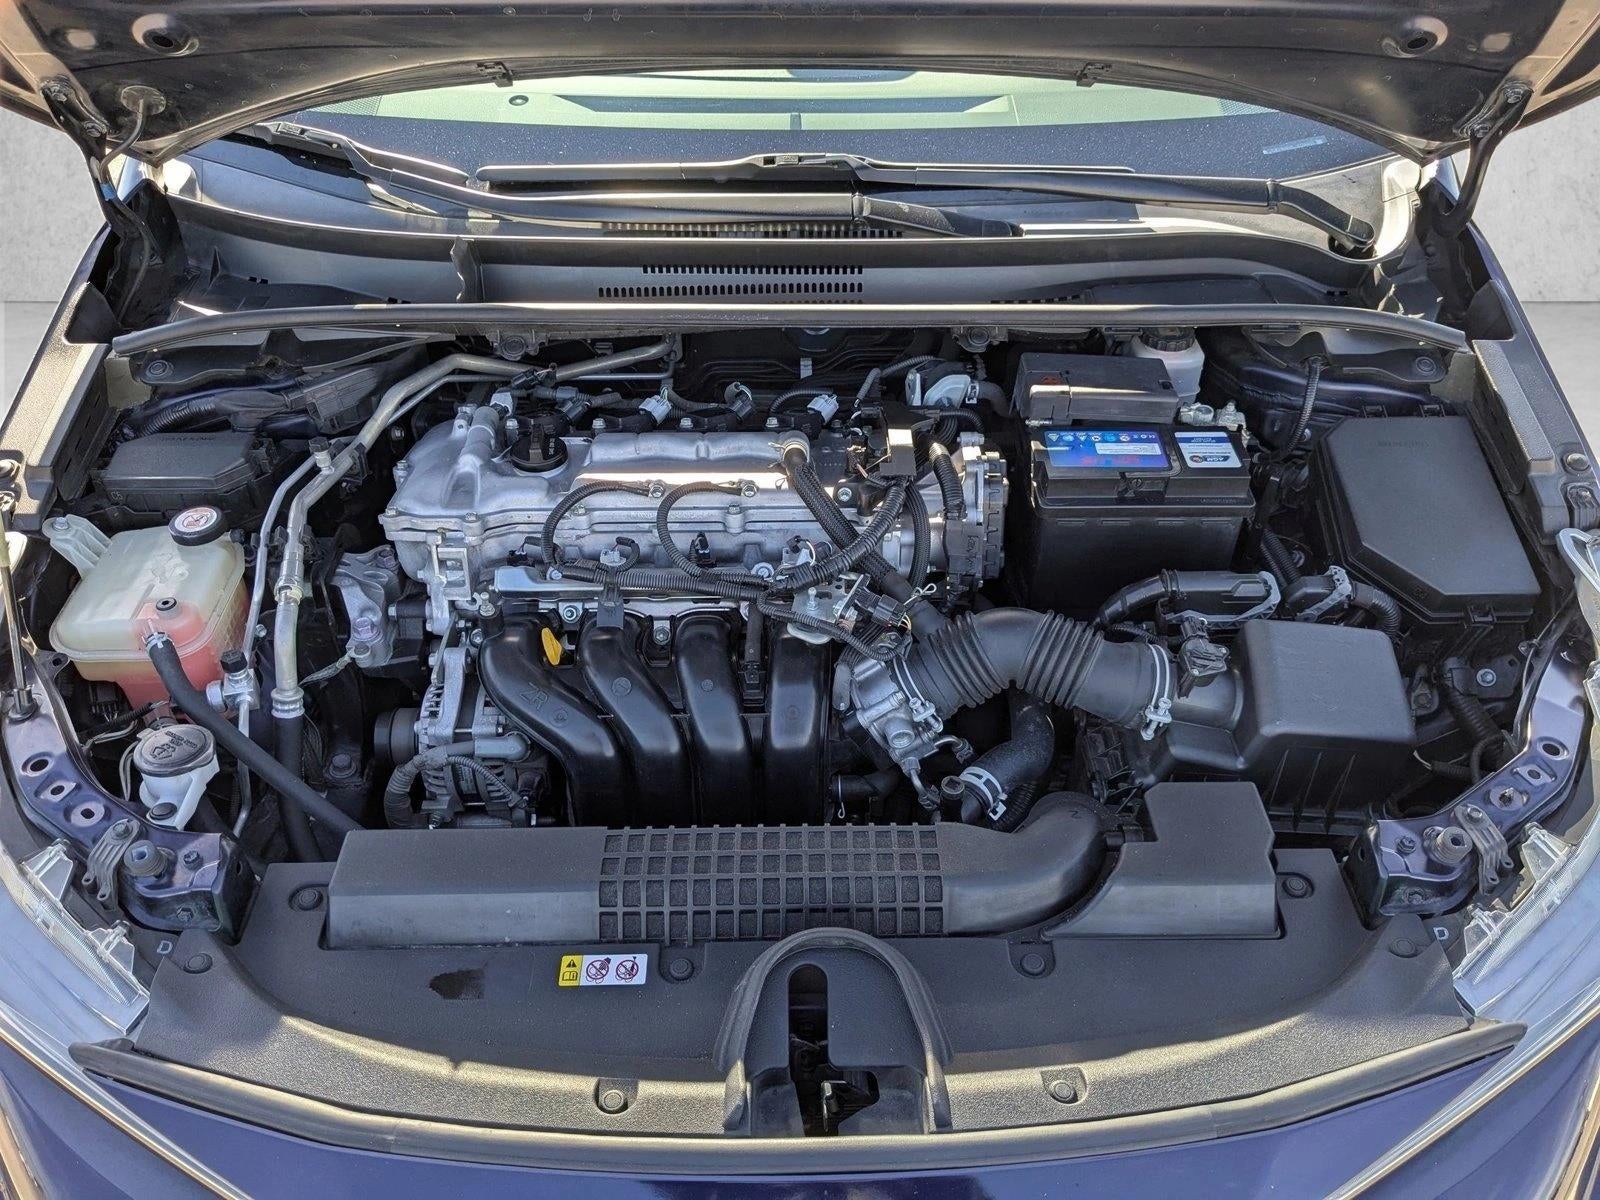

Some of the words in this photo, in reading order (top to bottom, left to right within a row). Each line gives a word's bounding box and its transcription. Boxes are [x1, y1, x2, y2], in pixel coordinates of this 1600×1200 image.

[519, 682, 550, 711] ZR
[1433, 927, 1449, 940] D
[157, 940, 173, 953] D
